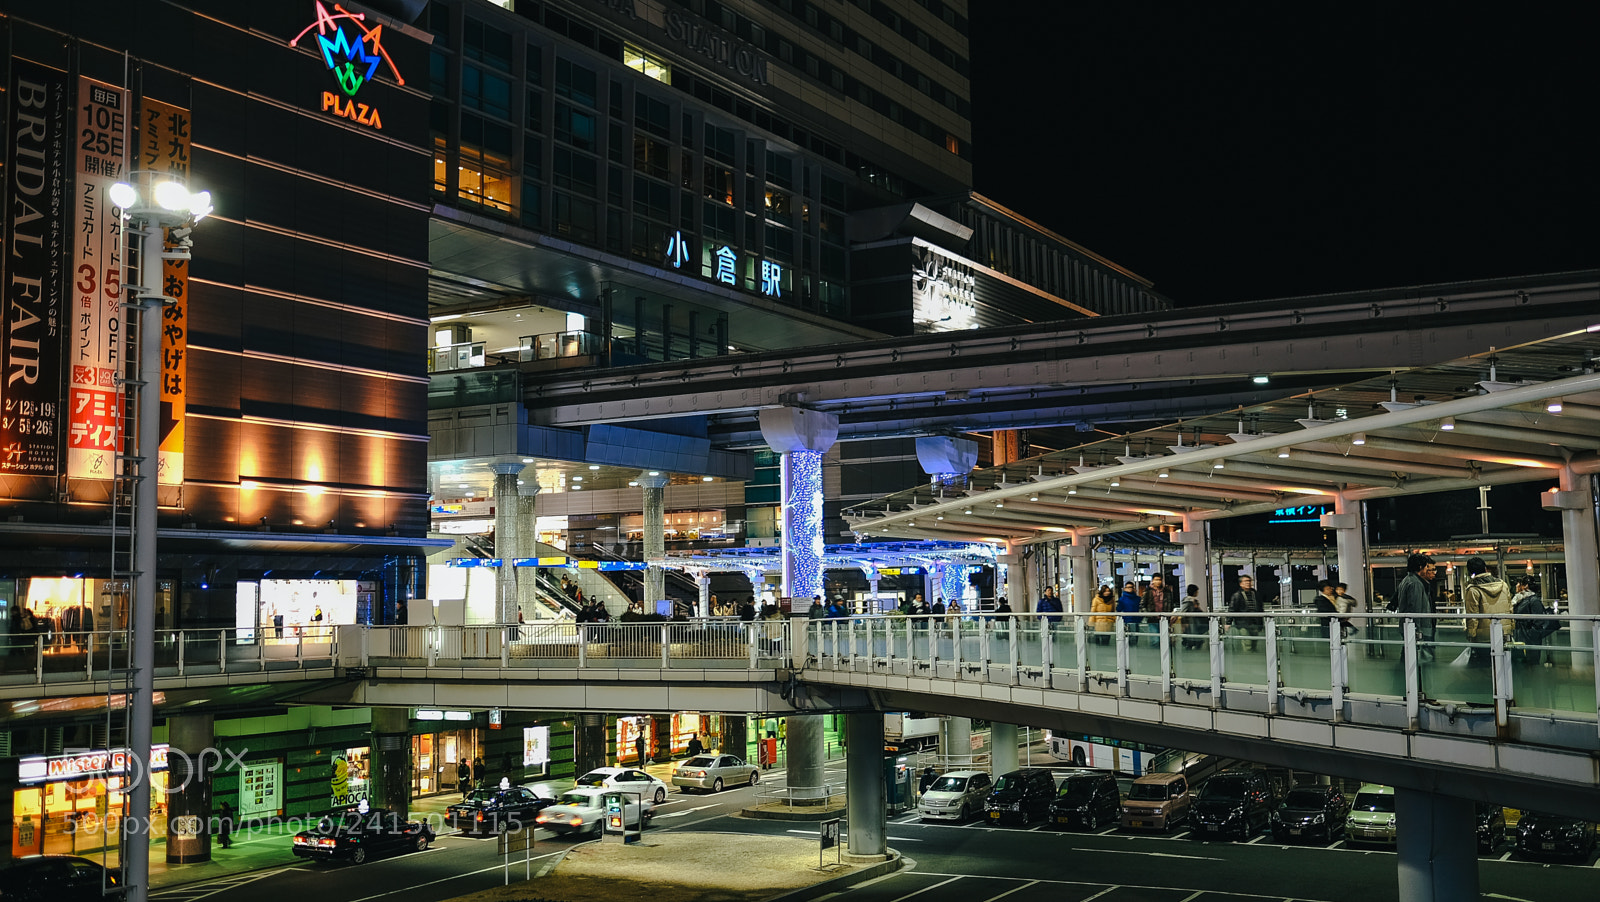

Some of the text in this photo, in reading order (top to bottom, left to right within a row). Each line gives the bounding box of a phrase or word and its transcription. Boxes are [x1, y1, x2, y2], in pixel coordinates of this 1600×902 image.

[664, 9, 768, 86] STATION
[94, 88, 118, 107] 毎月
[322, 91, 382, 129] PLAZA
[83, 104, 125, 133] 10日
[81, 129, 124, 158] 25日
[8, 75, 47, 388] BRIDAL FAIR
[666, 231, 781, 298] 小倉駅
[330, 791, 368, 807] APIOCA
